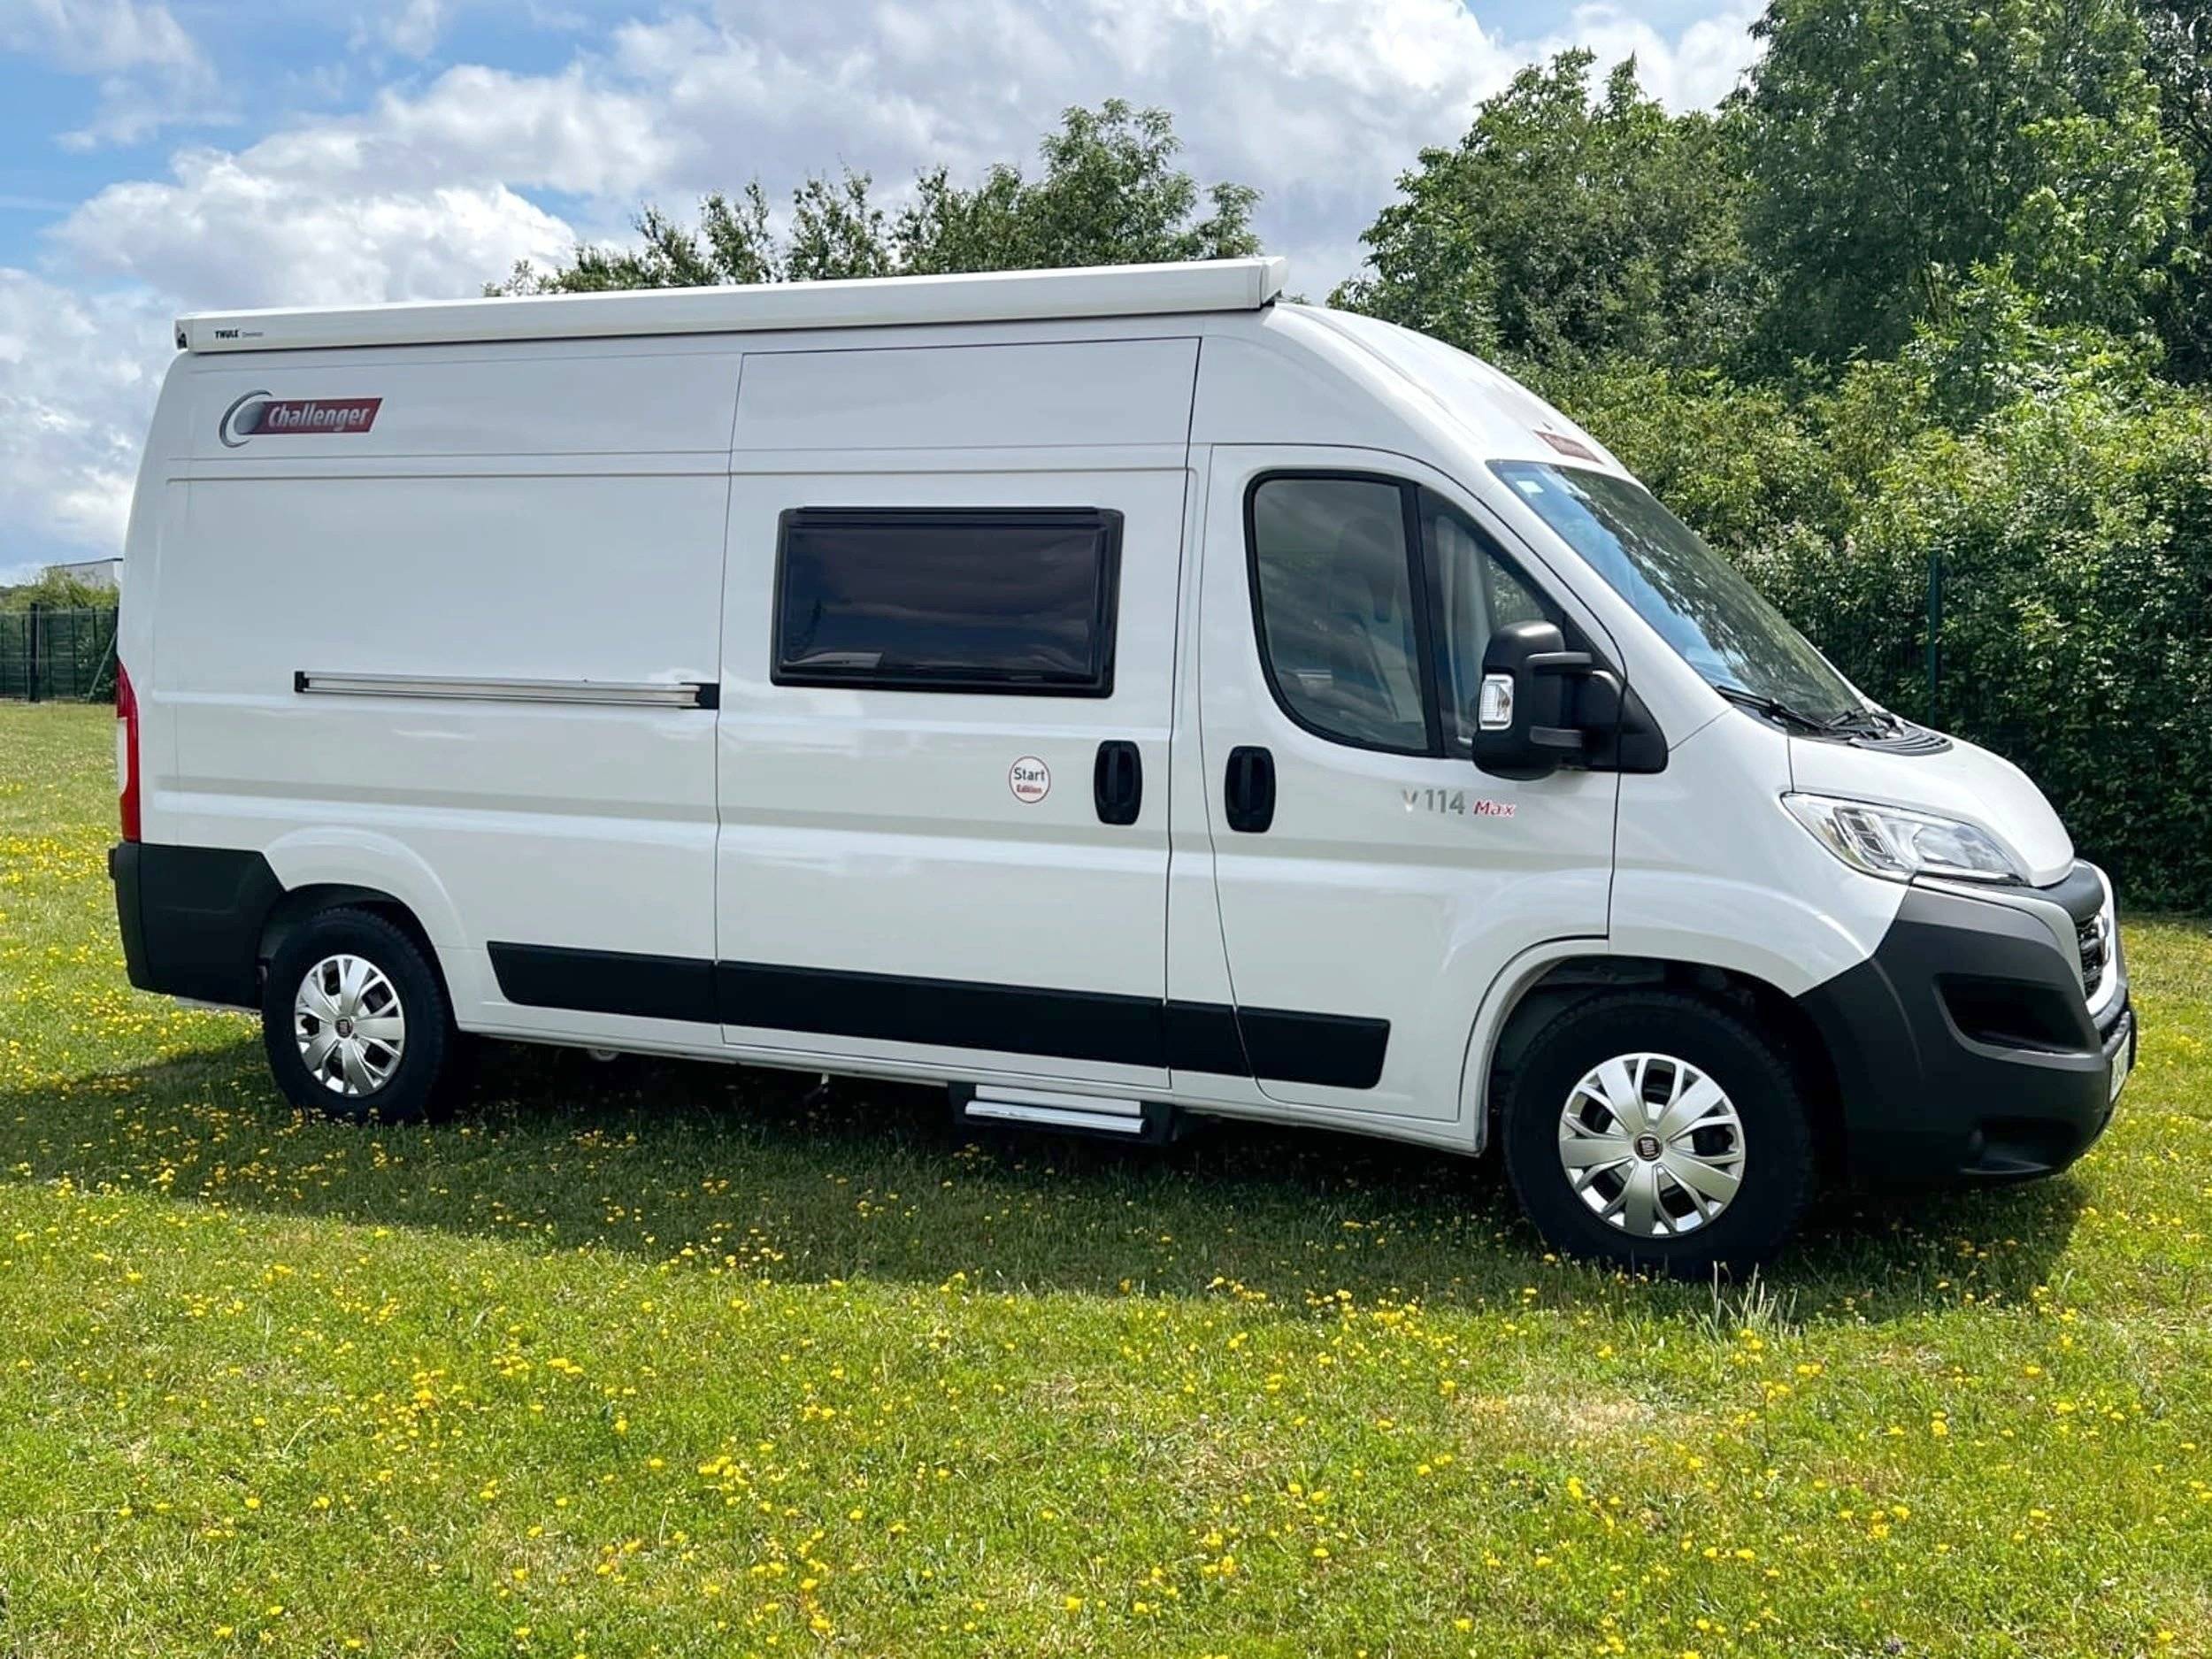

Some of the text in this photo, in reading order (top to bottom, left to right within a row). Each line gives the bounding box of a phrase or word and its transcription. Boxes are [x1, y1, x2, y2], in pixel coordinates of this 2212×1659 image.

[268, 403, 369, 432] Challenger
[1014, 767, 1045, 781] Start
[1425, 788, 1465, 815] 114
[1473, 800, 1514, 816] Max
